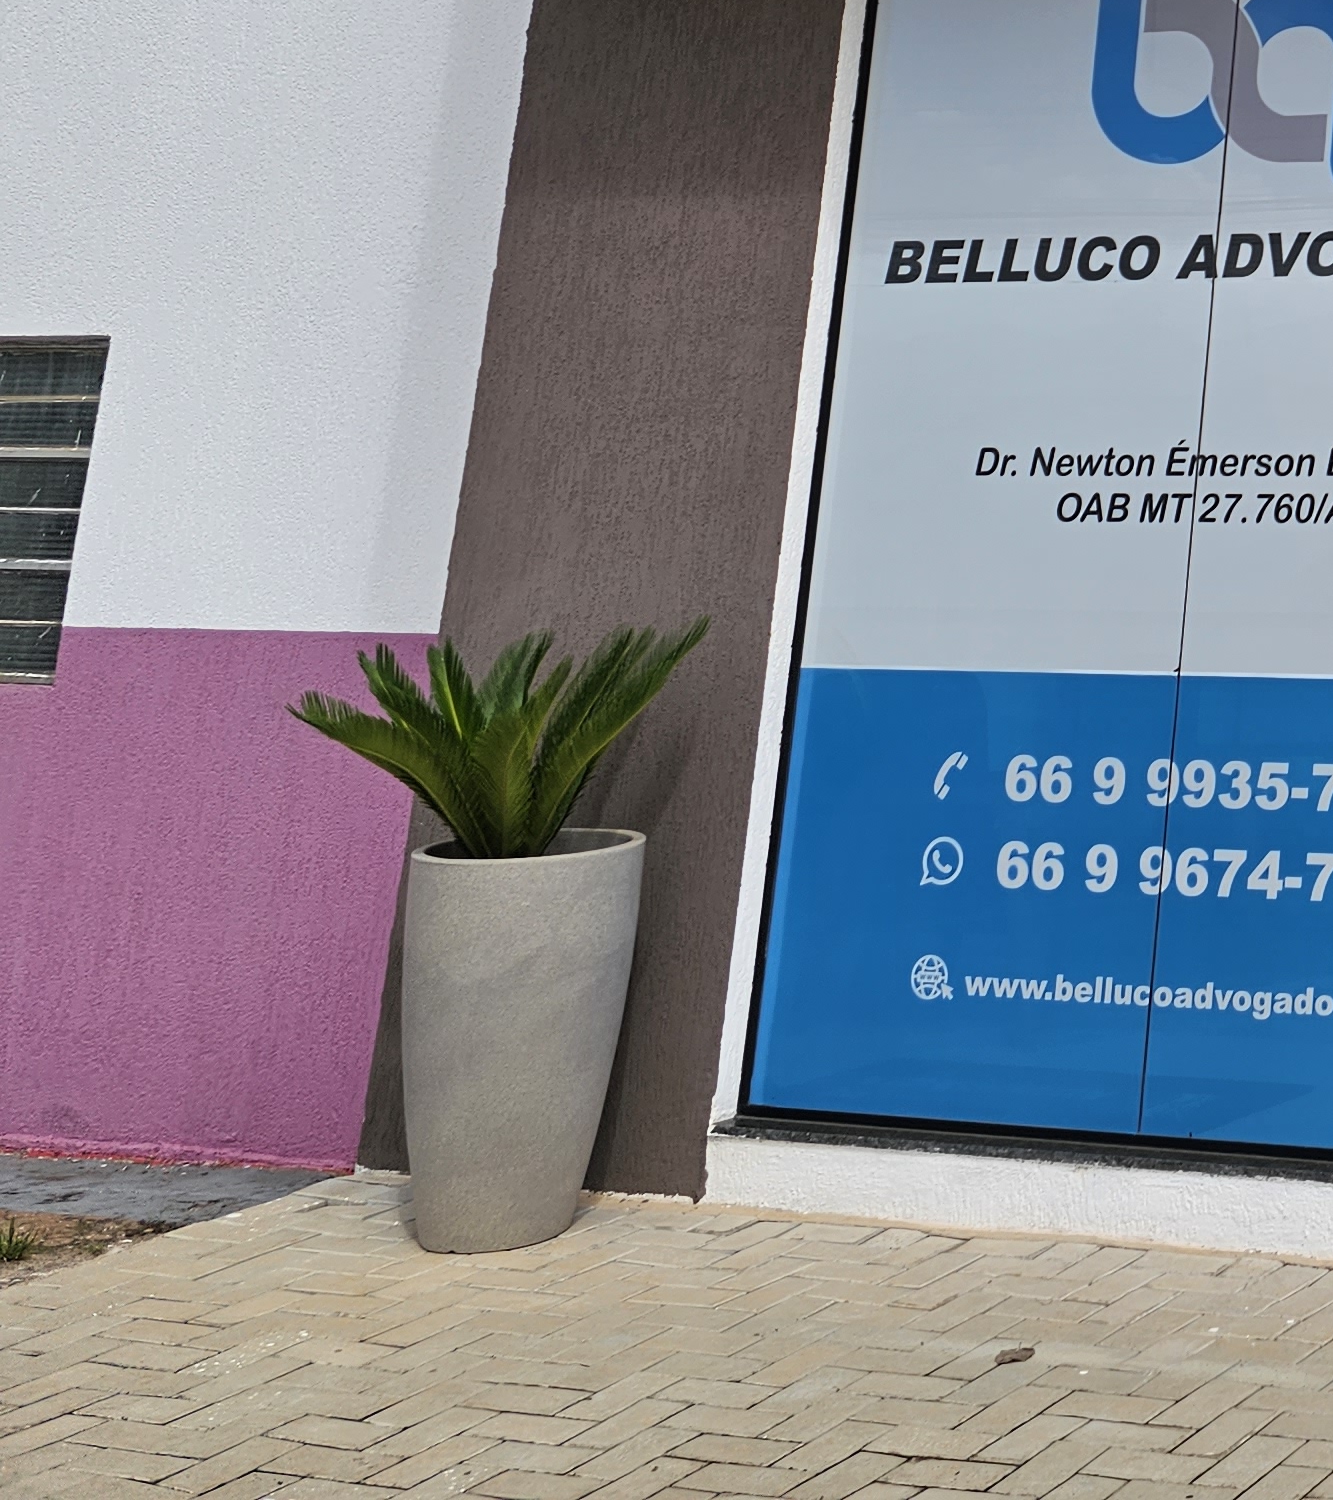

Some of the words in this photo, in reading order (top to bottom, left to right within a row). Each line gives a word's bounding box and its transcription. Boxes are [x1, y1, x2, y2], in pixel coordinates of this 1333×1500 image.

[884, 235, 1161, 285] BELLUCO
[976, 447, 1018, 477] Dr.
[1030, 447, 1155, 477] Newton
[1165, 439, 1316, 477] Émerson
[1056, 493, 1131, 523] OAB
[1139, 493, 1192, 524] MT
[1004, 754, 1073, 804] 66
[1092, 756, 1126, 805] 9
[996, 840, 1065, 891] 66
[1084, 843, 1119, 893] 9
